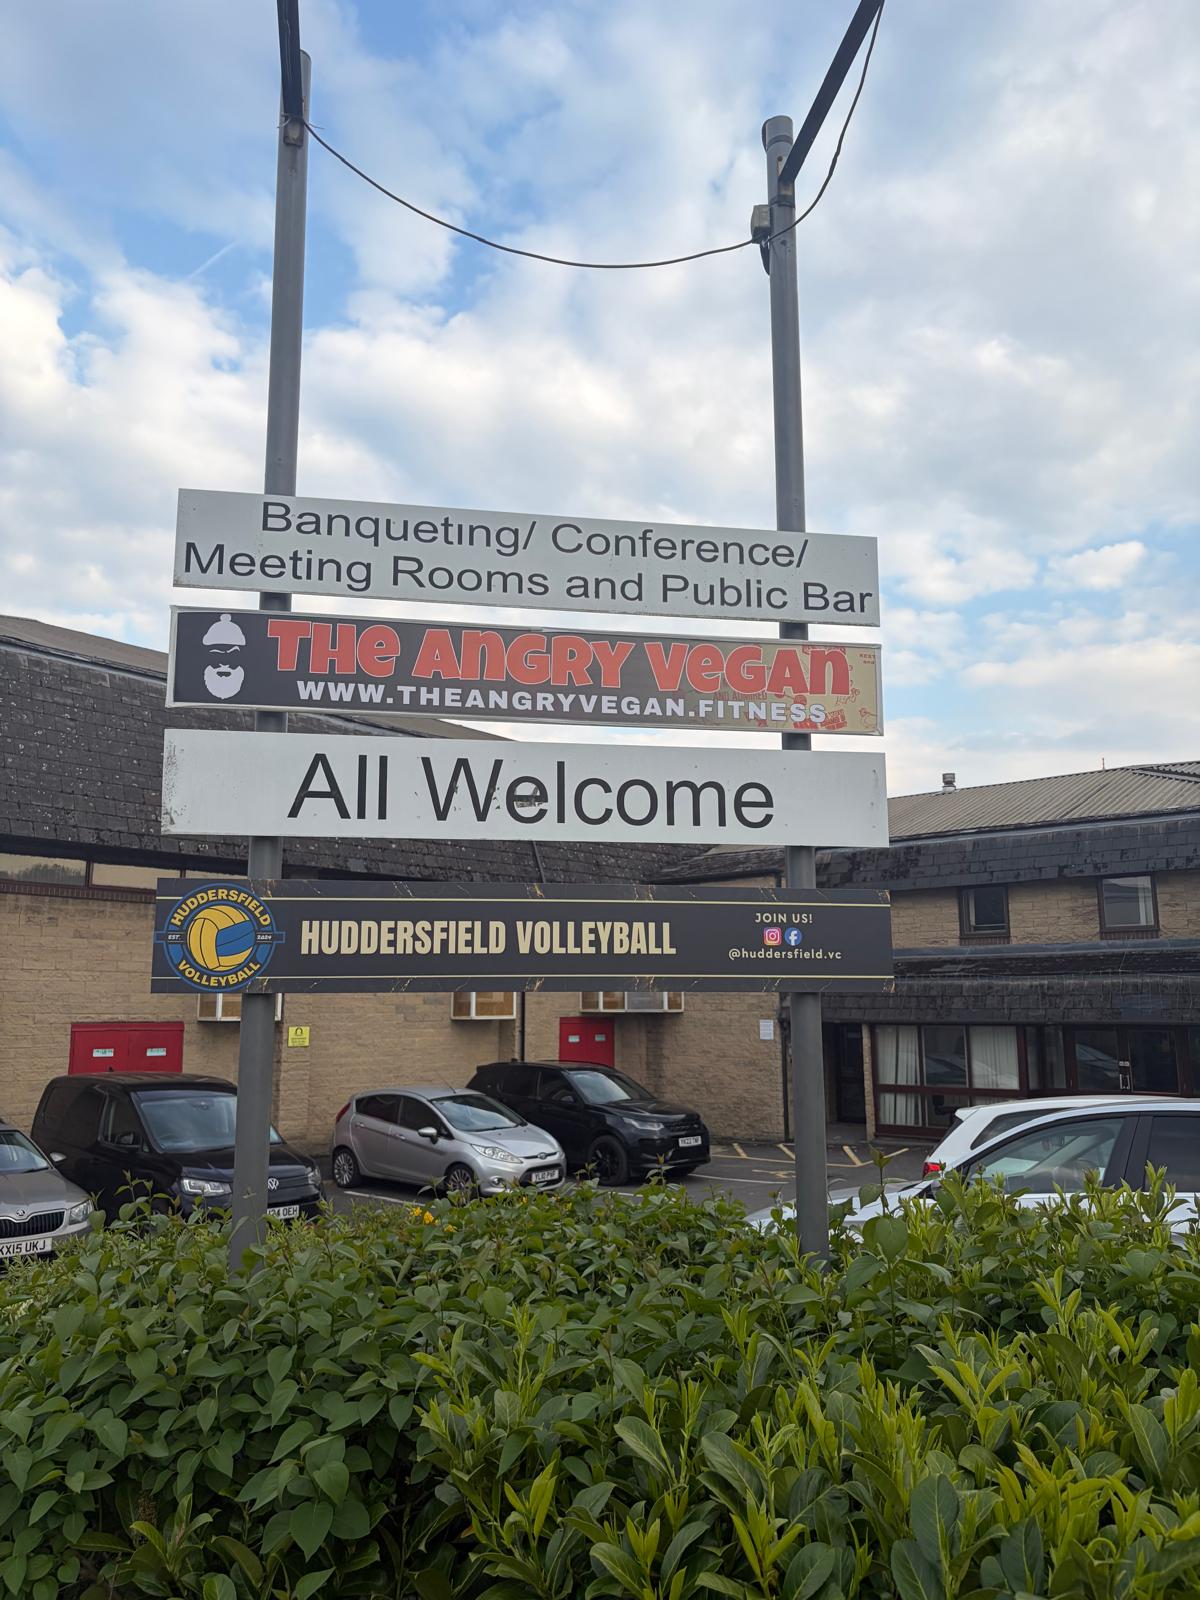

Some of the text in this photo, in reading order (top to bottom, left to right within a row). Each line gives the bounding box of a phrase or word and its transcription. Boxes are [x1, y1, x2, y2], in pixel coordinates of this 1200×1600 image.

[551, 523, 809, 568] Conference/
[184, 541, 873, 613] Meeting Rooms and Public Bar
[297, 680, 827, 724] WWW.THEANGRYVEGAN.FITNESS
[287, 752, 775, 829] All Welcome
[170, 888, 272, 927] HUDDERSFIELD
[754, 912, 813, 924] JOIN US!
[300, 920, 677, 955] HUDDERSFIELD VOLLEYBALL
[728, 947, 842, 960] @huddersfield.vc
[178, 959, 261, 987] VOLLEYBALL
[25, 1239, 46, 1253] UKJ
